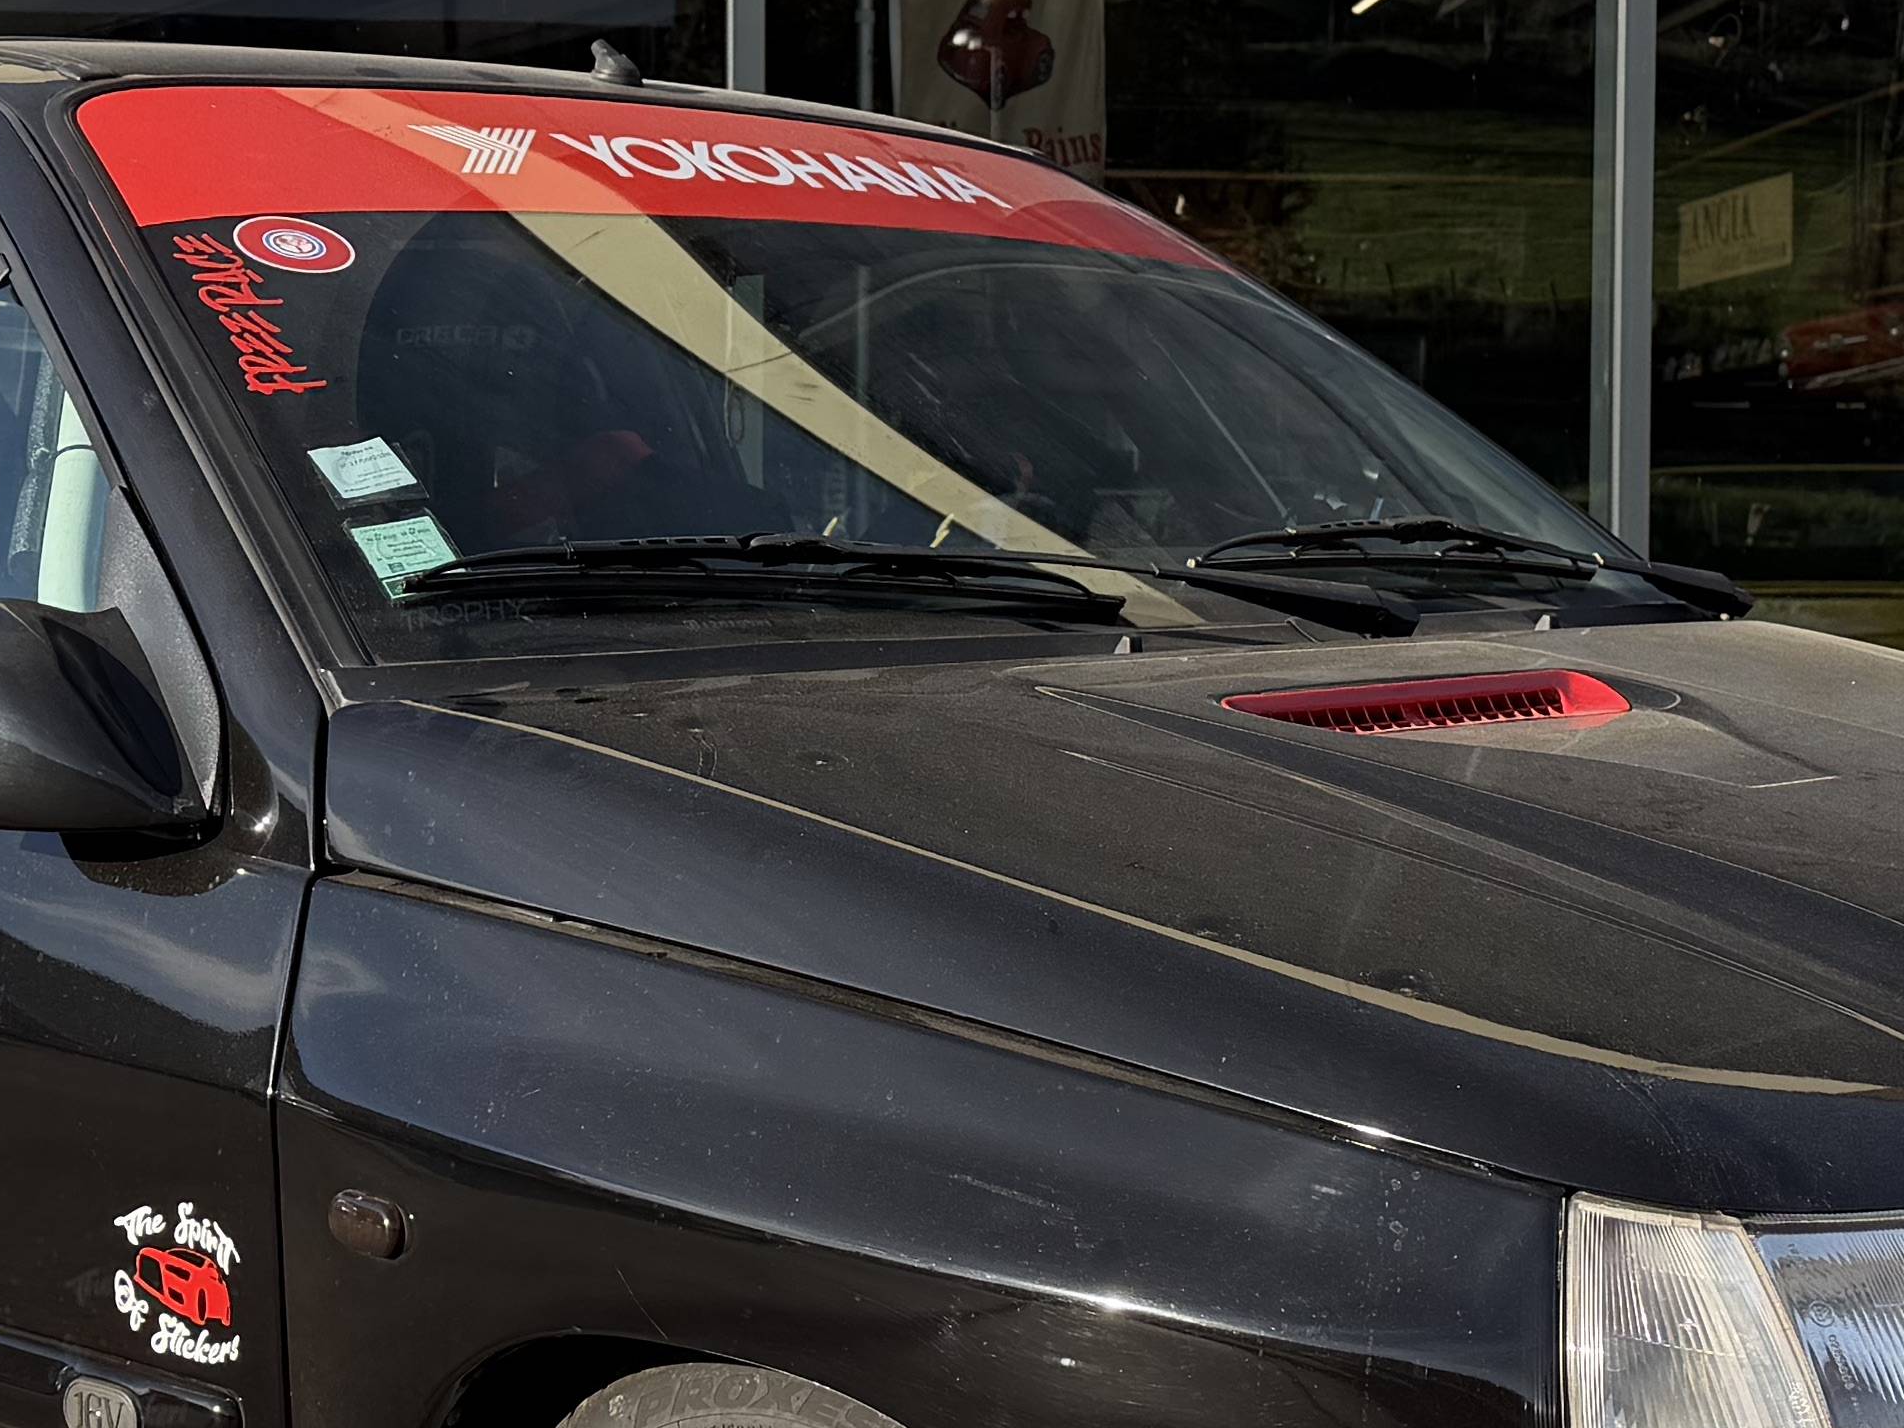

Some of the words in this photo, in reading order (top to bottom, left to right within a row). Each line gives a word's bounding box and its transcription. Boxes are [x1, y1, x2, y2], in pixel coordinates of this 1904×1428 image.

[548, 131, 1013, 210] YOKOHAMA
[114, 1205, 166, 1246] The
[174, 1202, 241, 1275] Spirit
[114, 1270, 149, 1331] Of
[151, 1313, 241, 1365] Stickers
